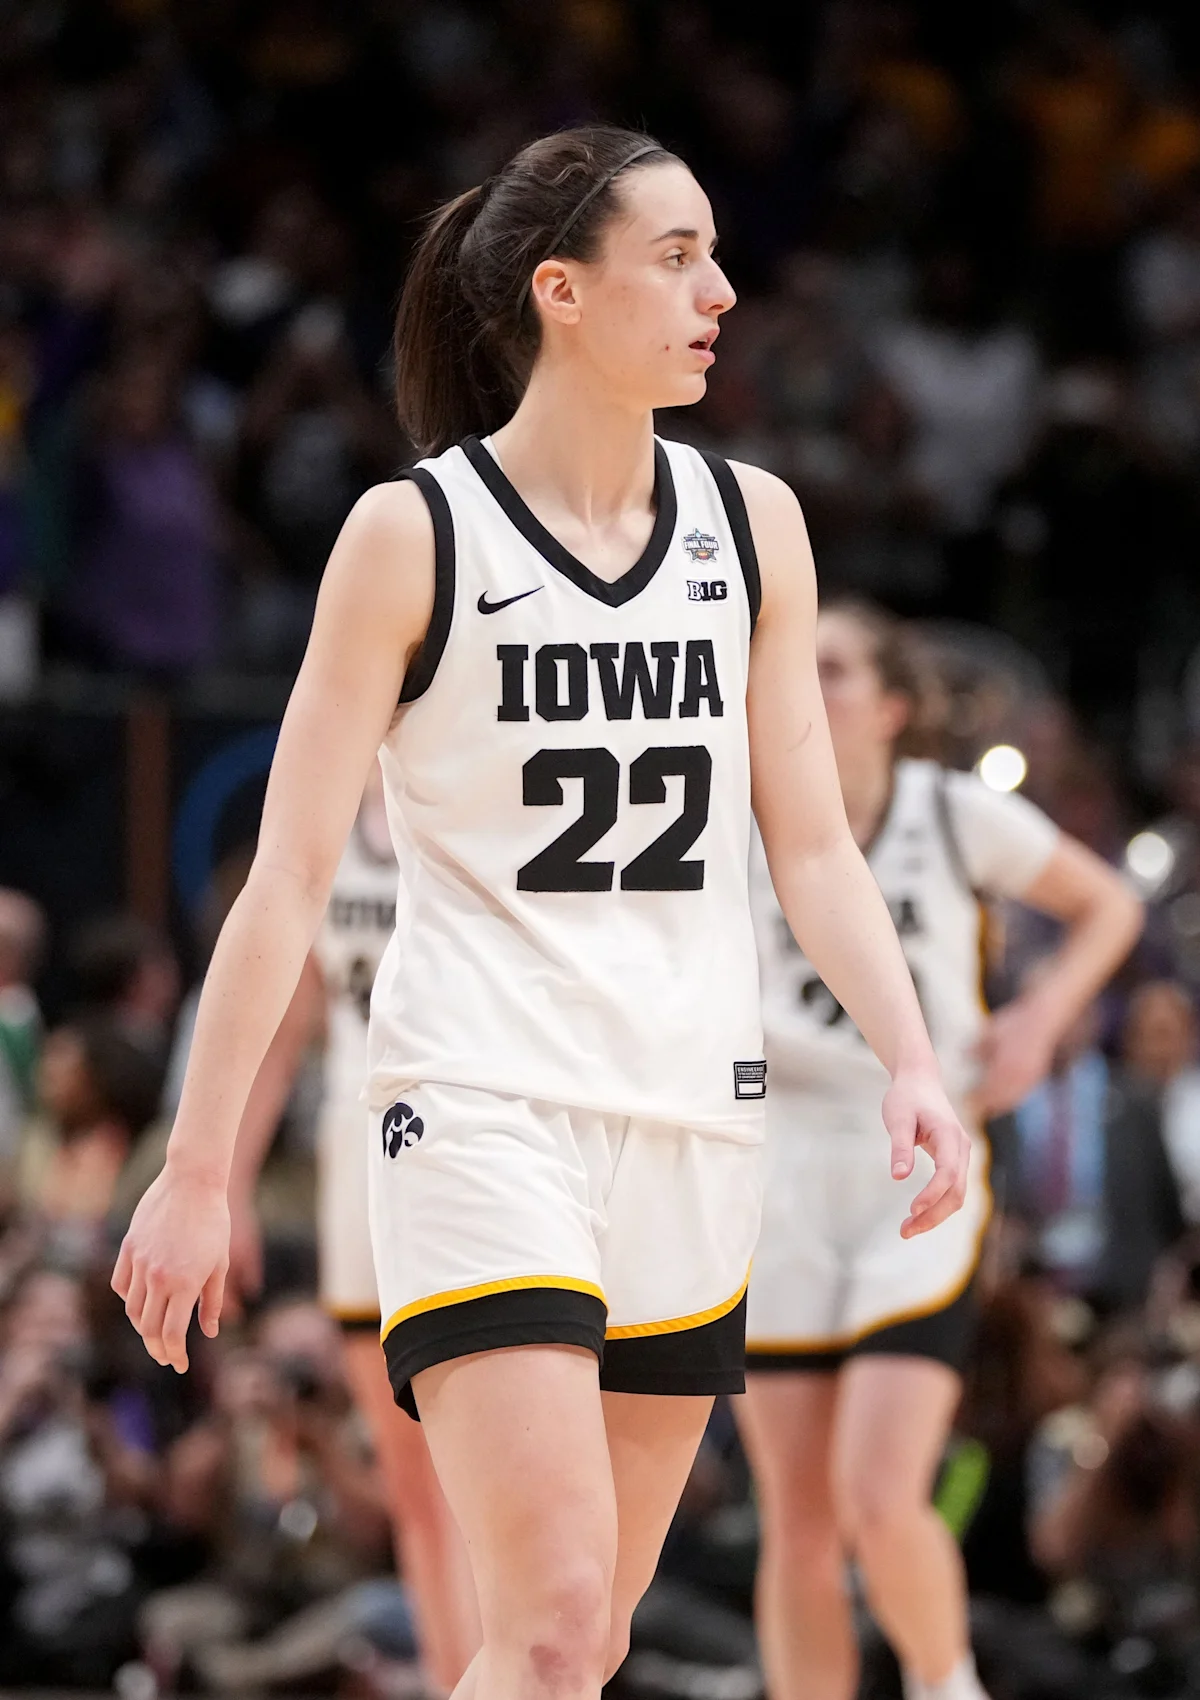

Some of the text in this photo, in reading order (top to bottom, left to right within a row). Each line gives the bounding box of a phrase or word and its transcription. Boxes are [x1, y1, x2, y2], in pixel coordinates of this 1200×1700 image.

[684, 540, 719, 550] FINAL FOUR
[497, 639, 724, 722] IOWA
[517, 745, 713, 892] 22
